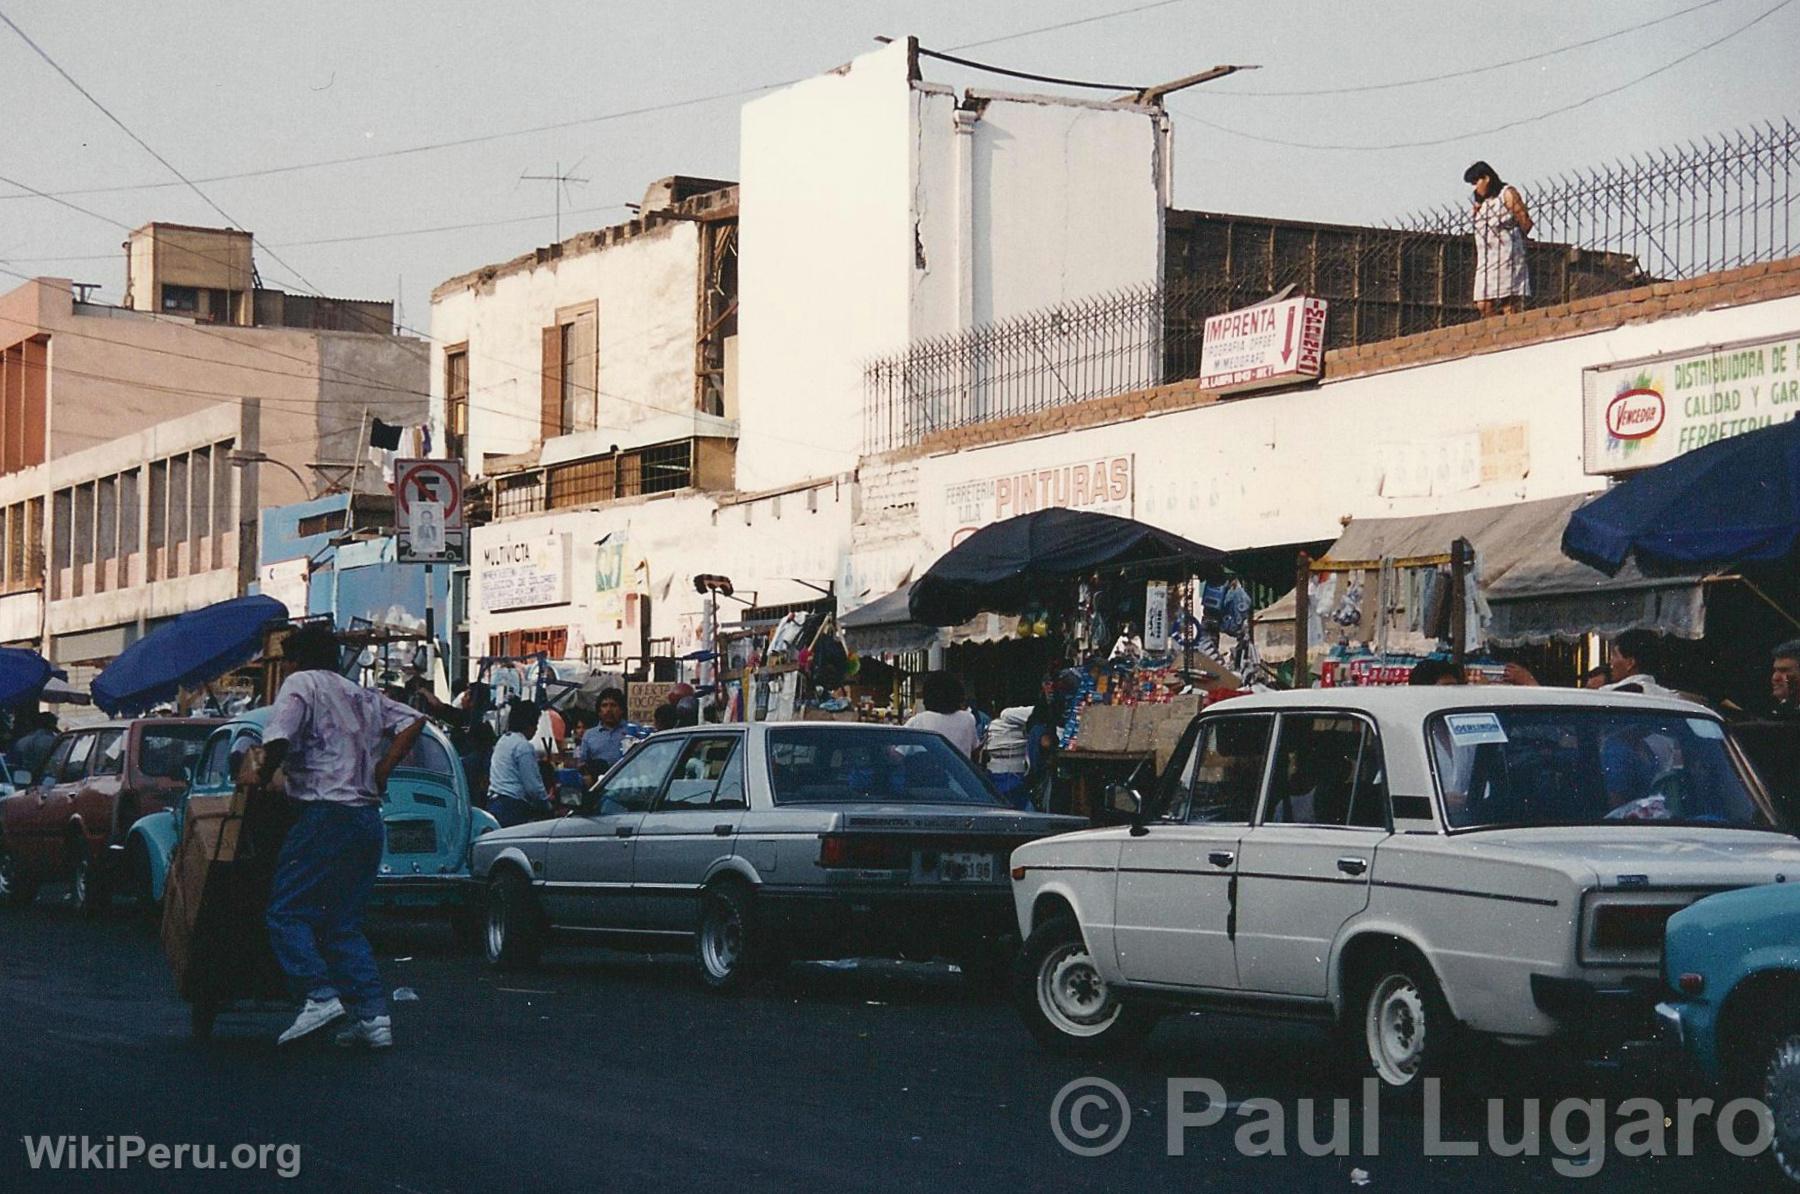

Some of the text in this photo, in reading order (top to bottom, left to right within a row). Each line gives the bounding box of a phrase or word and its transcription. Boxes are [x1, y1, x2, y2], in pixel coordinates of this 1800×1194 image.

[1206, 307, 1276, 343] IMPRENTA
[1301, 301, 1324, 363] IMPRENTA
[1674, 349, 1764, 391] DISTRIBUIDORA
[1771, 345, 1787, 374] DE
[1684, 389, 1742, 418] CALIDAD
[1751, 384, 1760, 409] Y
[946, 480, 995, 506] FERRETERIA
[996, 457, 1129, 519] PINTURAS
